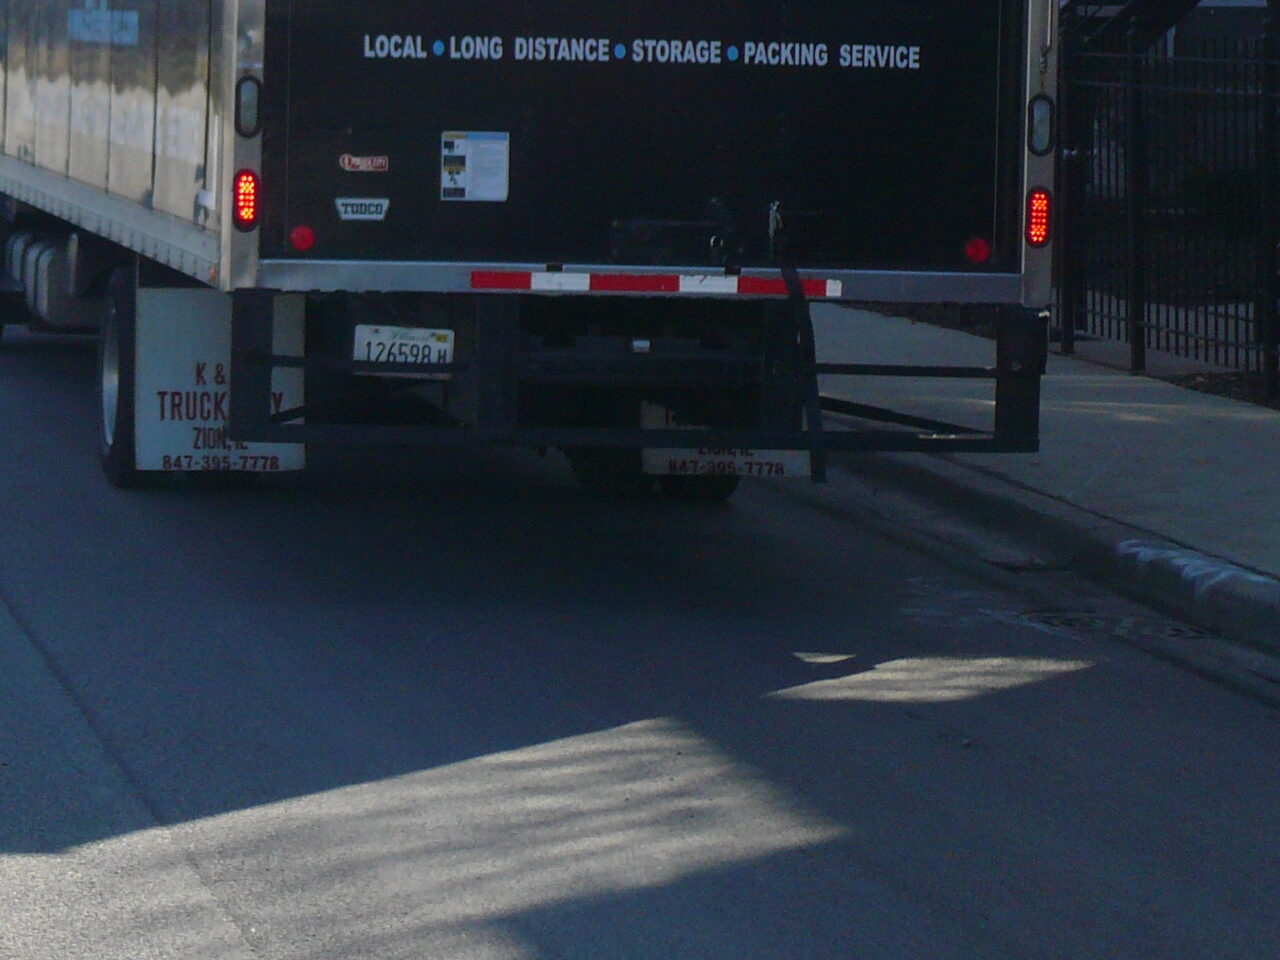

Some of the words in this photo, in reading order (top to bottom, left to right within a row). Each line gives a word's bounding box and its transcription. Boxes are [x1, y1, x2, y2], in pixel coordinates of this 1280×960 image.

[363, 34, 427, 59] LOCAL
[450, 36, 503, 60] LONG
[514, 38, 609, 62] DISTANCE
[631, 40, 721, 64] STORAGE
[743, 42, 828, 67] PACKING
[839, 44, 921, 69] SERVICE
[340, 203, 384, 215] TODCO
[195, 362, 207, 385] K
[214, 363, 227, 385] &
[157, 391, 228, 421] TRUCK
[162, 454, 280, 471] 847-395-7778
